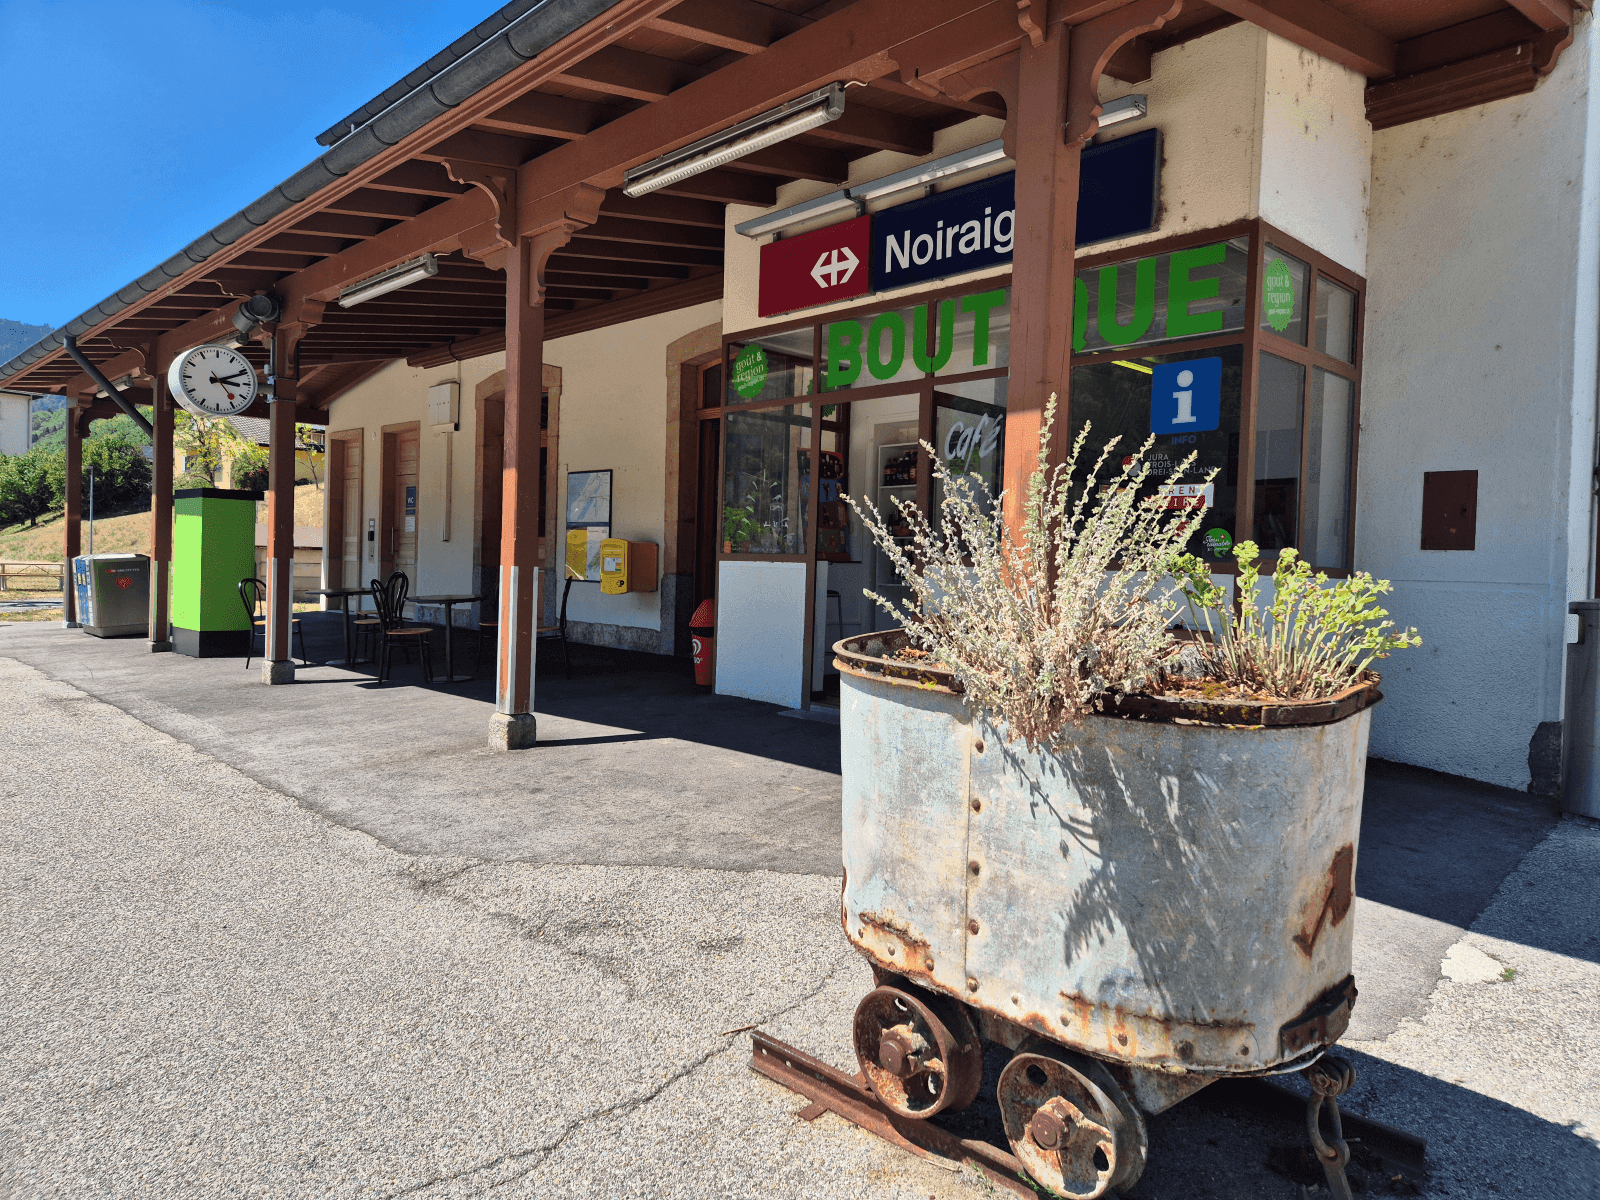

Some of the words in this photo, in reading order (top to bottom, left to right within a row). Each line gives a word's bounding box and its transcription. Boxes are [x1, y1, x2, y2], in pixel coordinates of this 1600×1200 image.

[885, 207, 1015, 273] Noiraig
[827, 243, 1226, 388] BOUTUE
[756, 351, 763, 361] &
[944, 412, 1004, 472] Café
[1148, 454, 1169, 462] JURA
[1171, 435, 1197, 446] INFO
